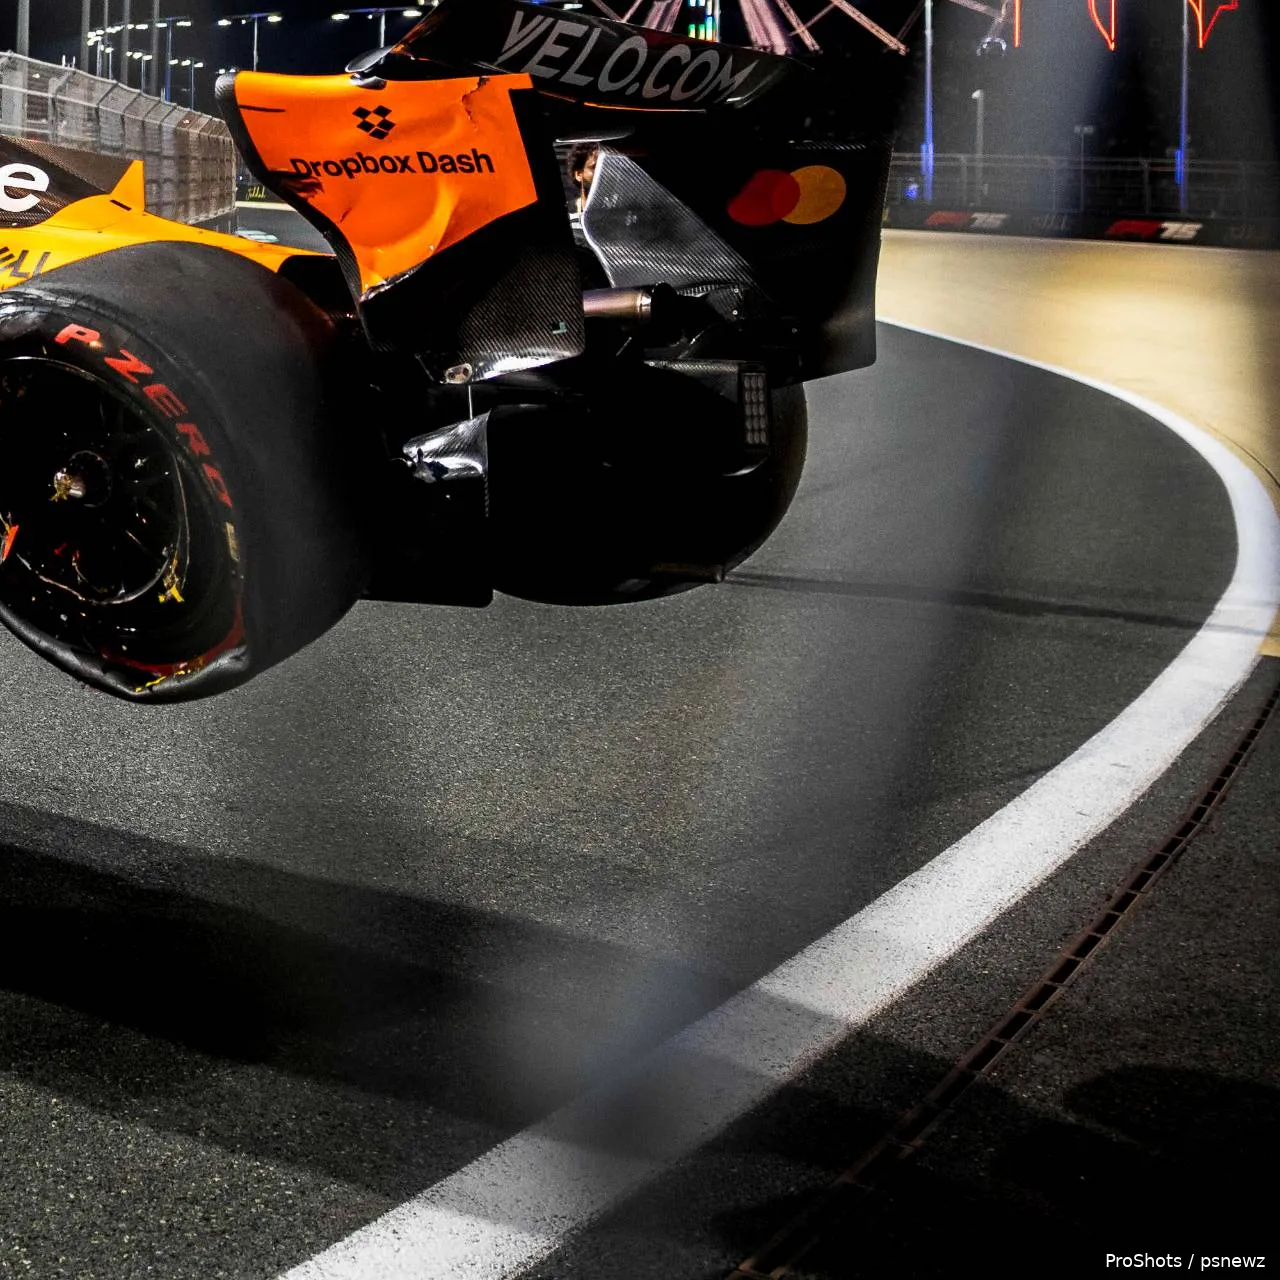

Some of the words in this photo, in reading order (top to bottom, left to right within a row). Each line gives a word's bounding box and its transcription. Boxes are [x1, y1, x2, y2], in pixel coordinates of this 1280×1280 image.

[497, 11, 758, 104] VELO.COM
[291, 149, 414, 181] Dropbox
[419, 147, 494, 175] Dash
